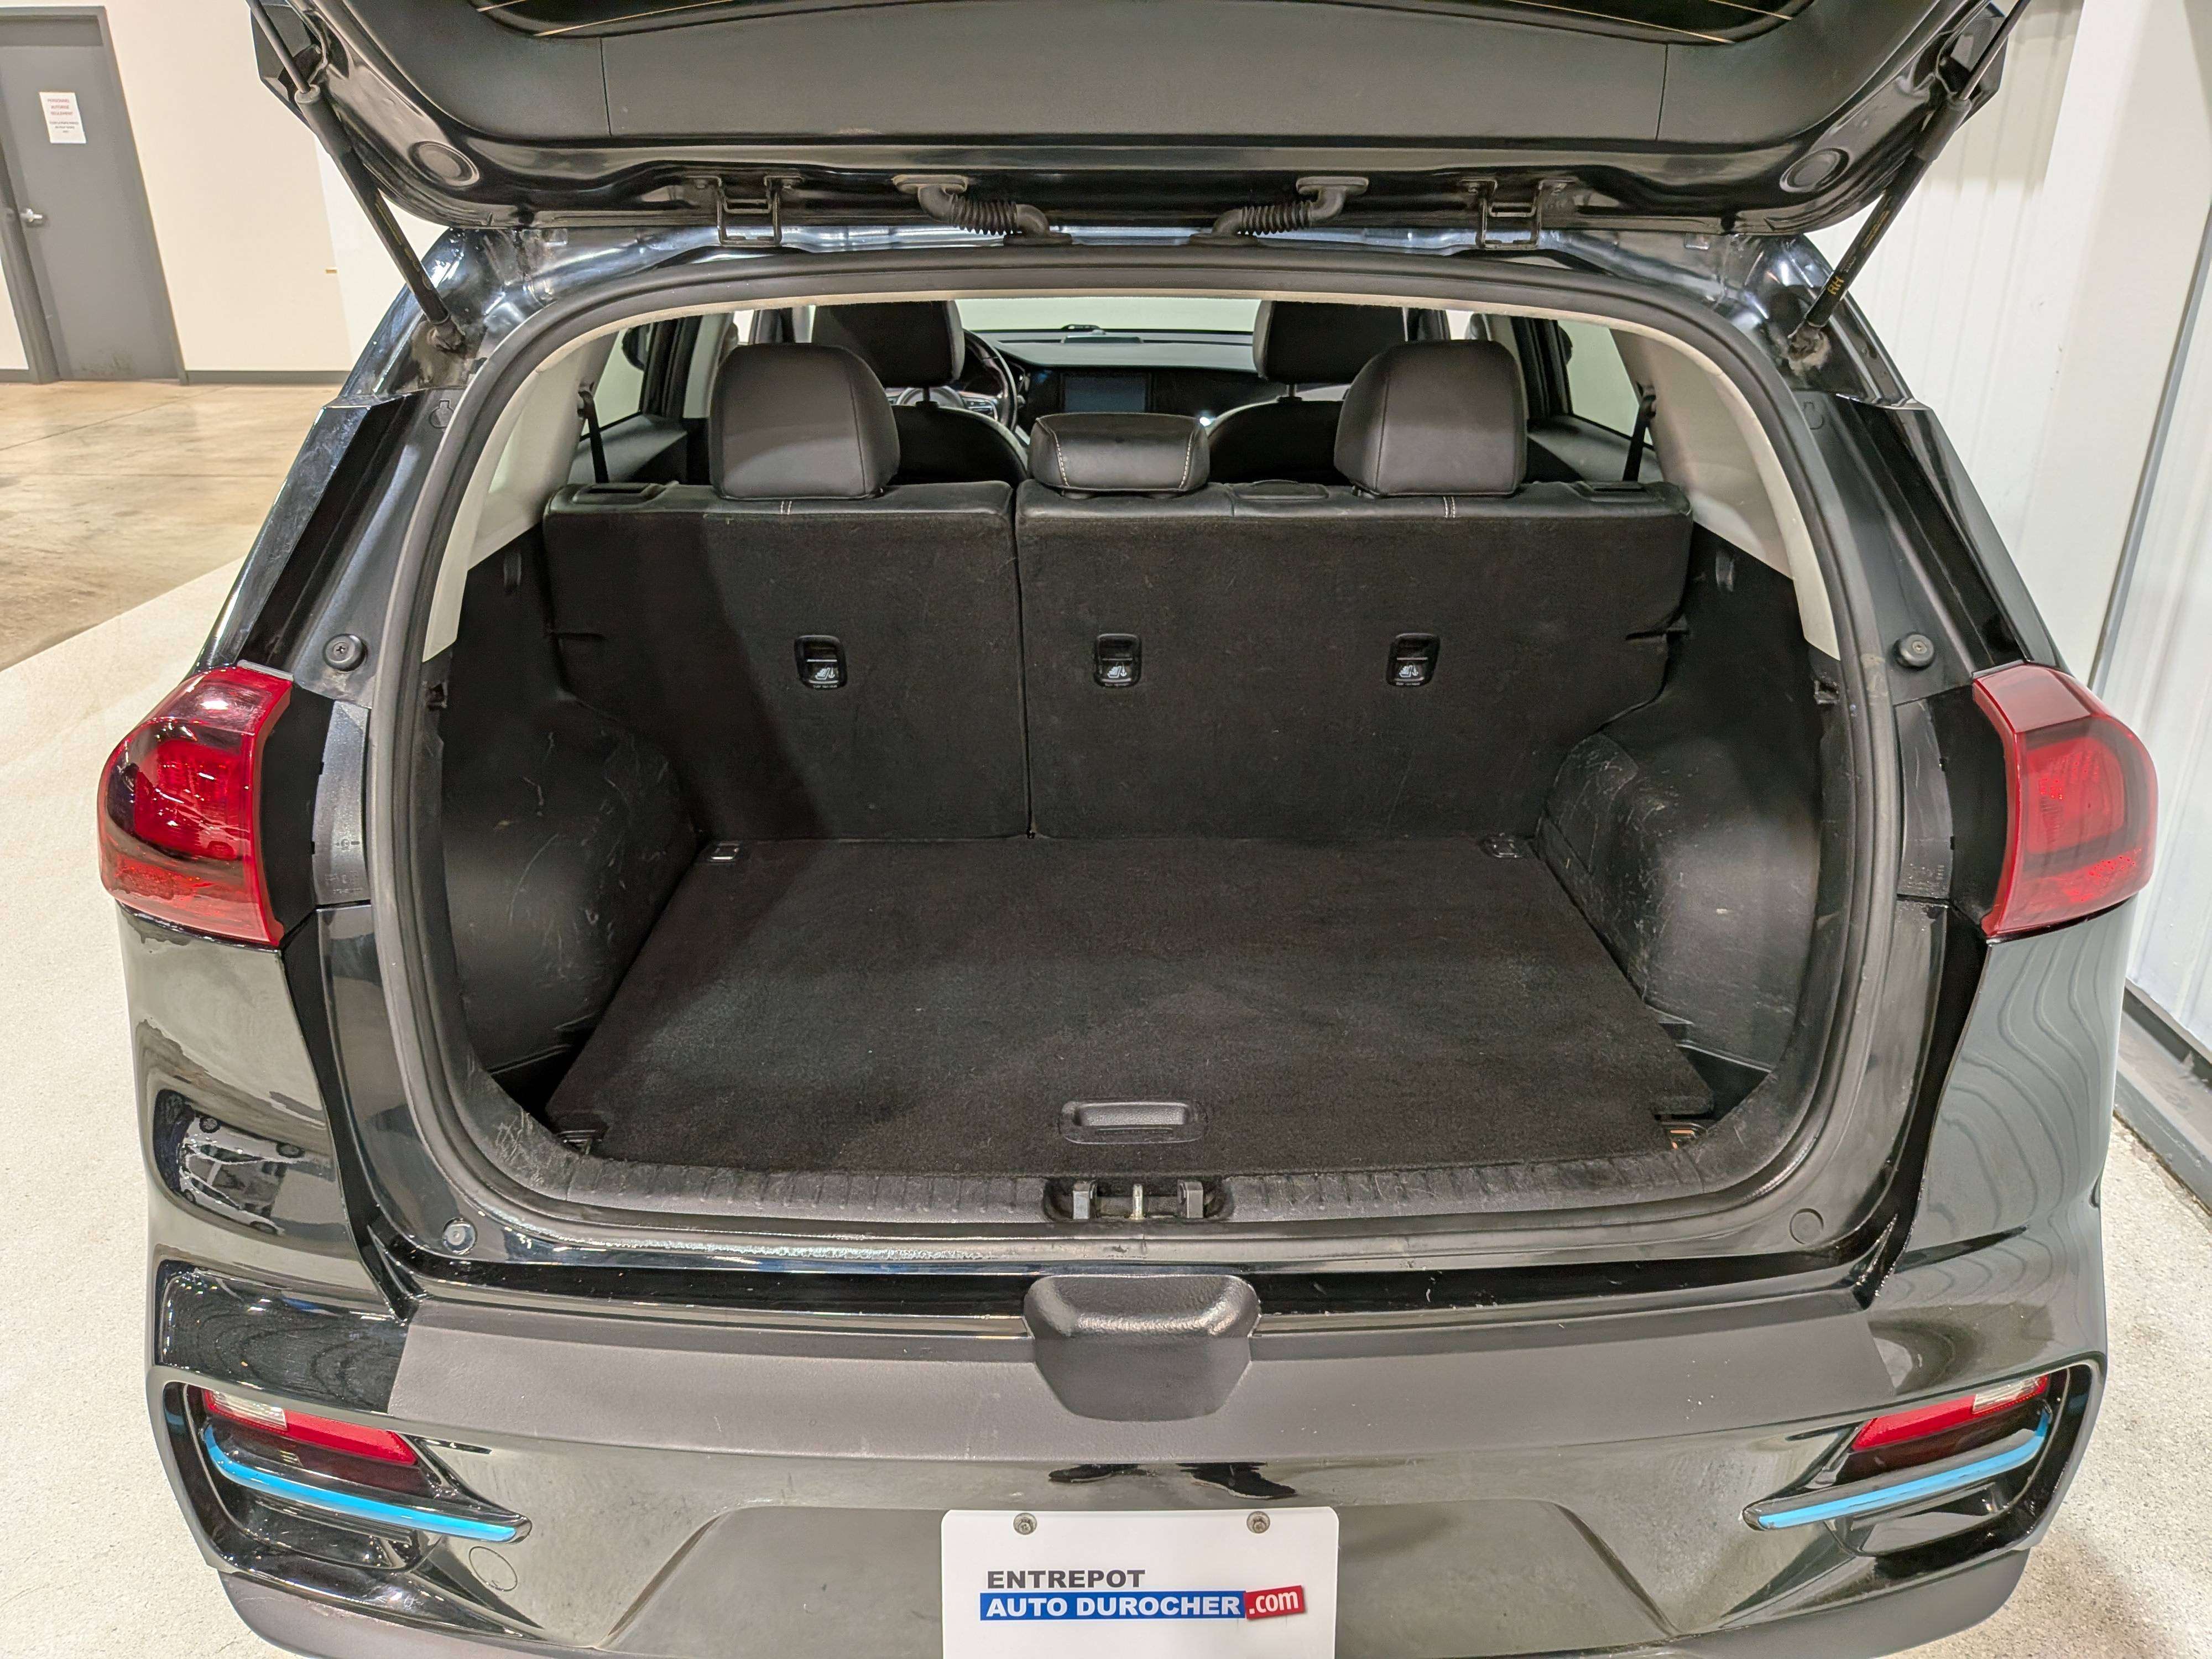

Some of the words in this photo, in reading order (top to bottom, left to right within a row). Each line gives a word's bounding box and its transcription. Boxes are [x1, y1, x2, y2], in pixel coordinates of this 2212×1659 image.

[1827, 276, 1844, 295] RH
[988, 1569, 1145, 1589] ENTREPOT
[986, 1598, 1068, 1617] AUTO
[1076, 1596, 1241, 1616] DUROCHER
[1249, 1590, 1299, 1614] .com
